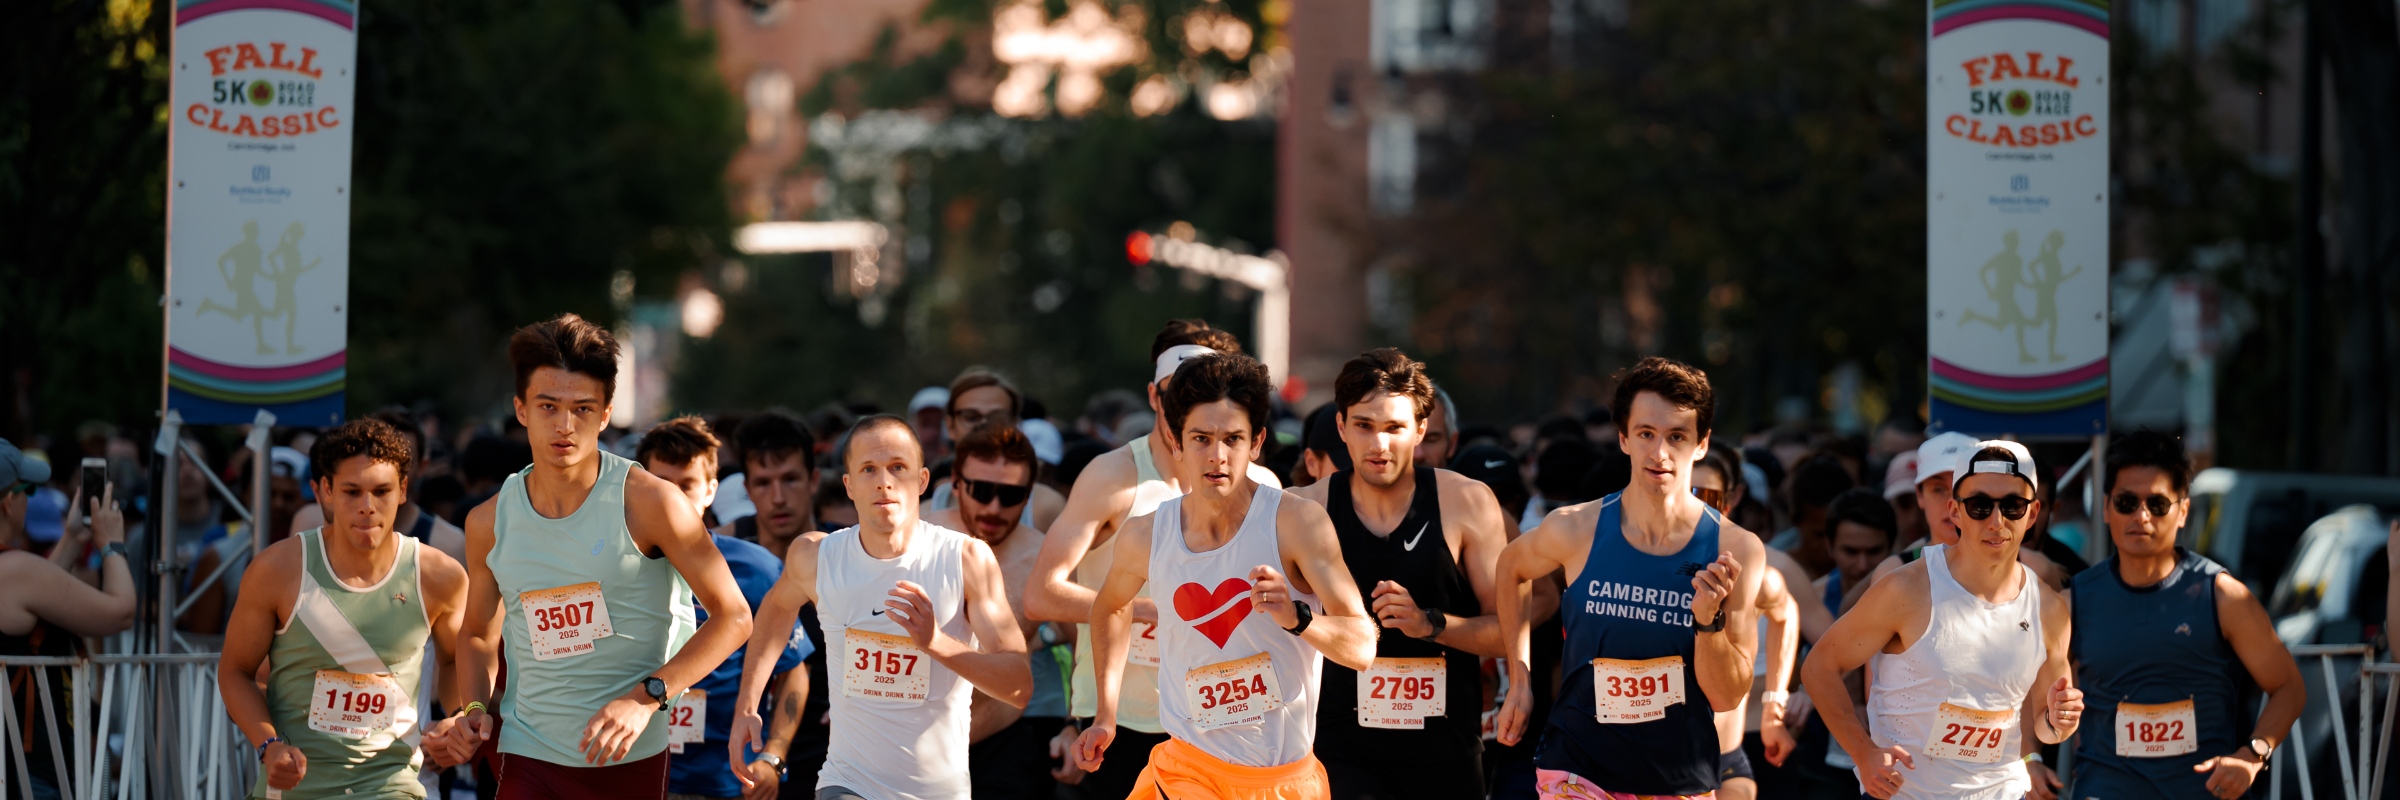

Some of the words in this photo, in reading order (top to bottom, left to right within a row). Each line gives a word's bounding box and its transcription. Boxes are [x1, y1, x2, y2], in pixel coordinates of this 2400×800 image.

[204, 41, 323, 79] FALL
[1960, 51, 2079, 89] FALL
[213, 79, 246, 104] 5K
[1970, 90, 2003, 115] 5K
[186, 103, 340, 137] CLASSIC
[1944, 113, 2097, 148] CLASSIC
[1588, 580, 1693, 610] CAMBRIDG
[534, 600, 594, 632] 3507
[1585, 600, 1657, 622] RUNNING
[1662, 611, 1693, 628] CLU
[558, 629, 580, 640] 2025
[552, 646, 572, 655] DRINK
[573, 642, 593, 652] DRINK
[855, 647, 918, 676] 3157
[874, 675, 895, 684] 2025
[1198, 673, 1268, 710] 3254
[1370, 675, 1435, 700] 2795
[1606, 673, 1669, 698] 3391
[326, 688, 386, 715] 1199
[863, 688, 883, 697] DRINK
[885, 691, 905, 699] DRINK
[1629, 699, 1652, 707] 2025
[341, 713, 362, 723] 2025
[669, 706, 693, 727] 32
[1226, 702, 1249, 715] 2025
[1391, 702, 1413, 711] 2025
[1643, 710, 1663, 718] DRINK
[329, 725, 348, 733] DRINK
[1241, 714, 1262, 724] DRINK
[1381, 717, 1401, 725] DRINK
[2125, 719, 2185, 743] 1822
[1941, 722, 2003, 749] 2779
[1958, 748, 1978, 758] 2025
[2144, 744, 2165, 752] 2025
